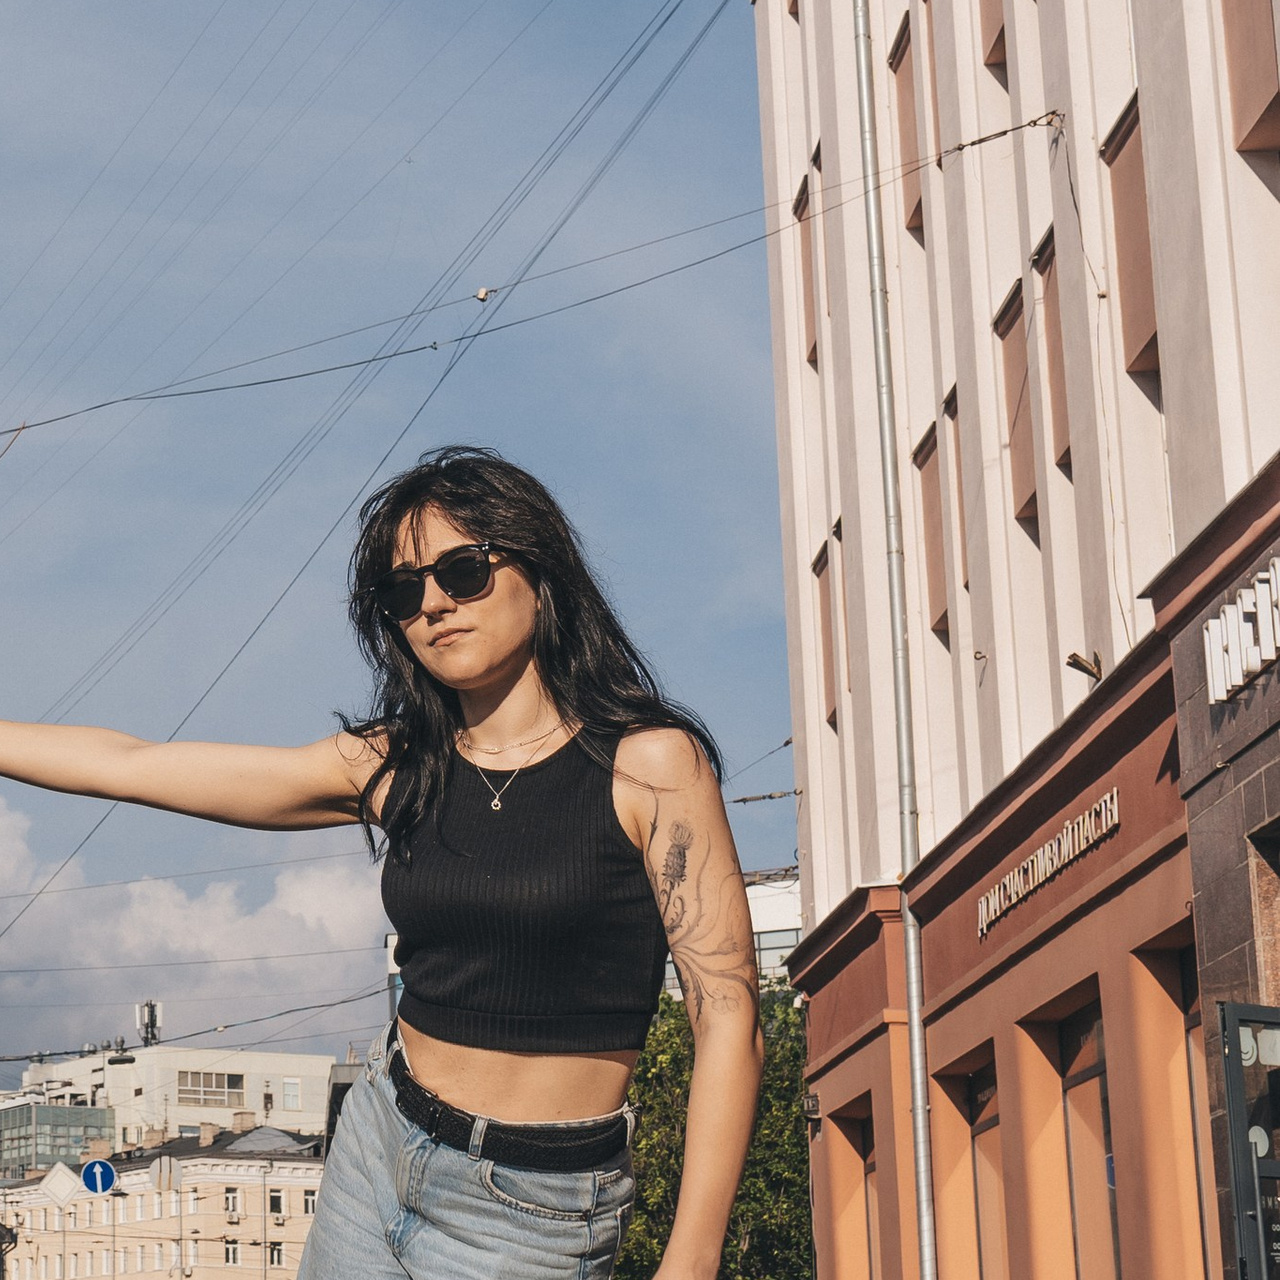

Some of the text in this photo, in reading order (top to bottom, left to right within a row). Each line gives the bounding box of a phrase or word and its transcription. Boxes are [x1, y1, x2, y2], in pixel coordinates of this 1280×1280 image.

[978, 786, 1119, 938] ДОМ СЧАСТЛИВОЙ ПАСТЫ
